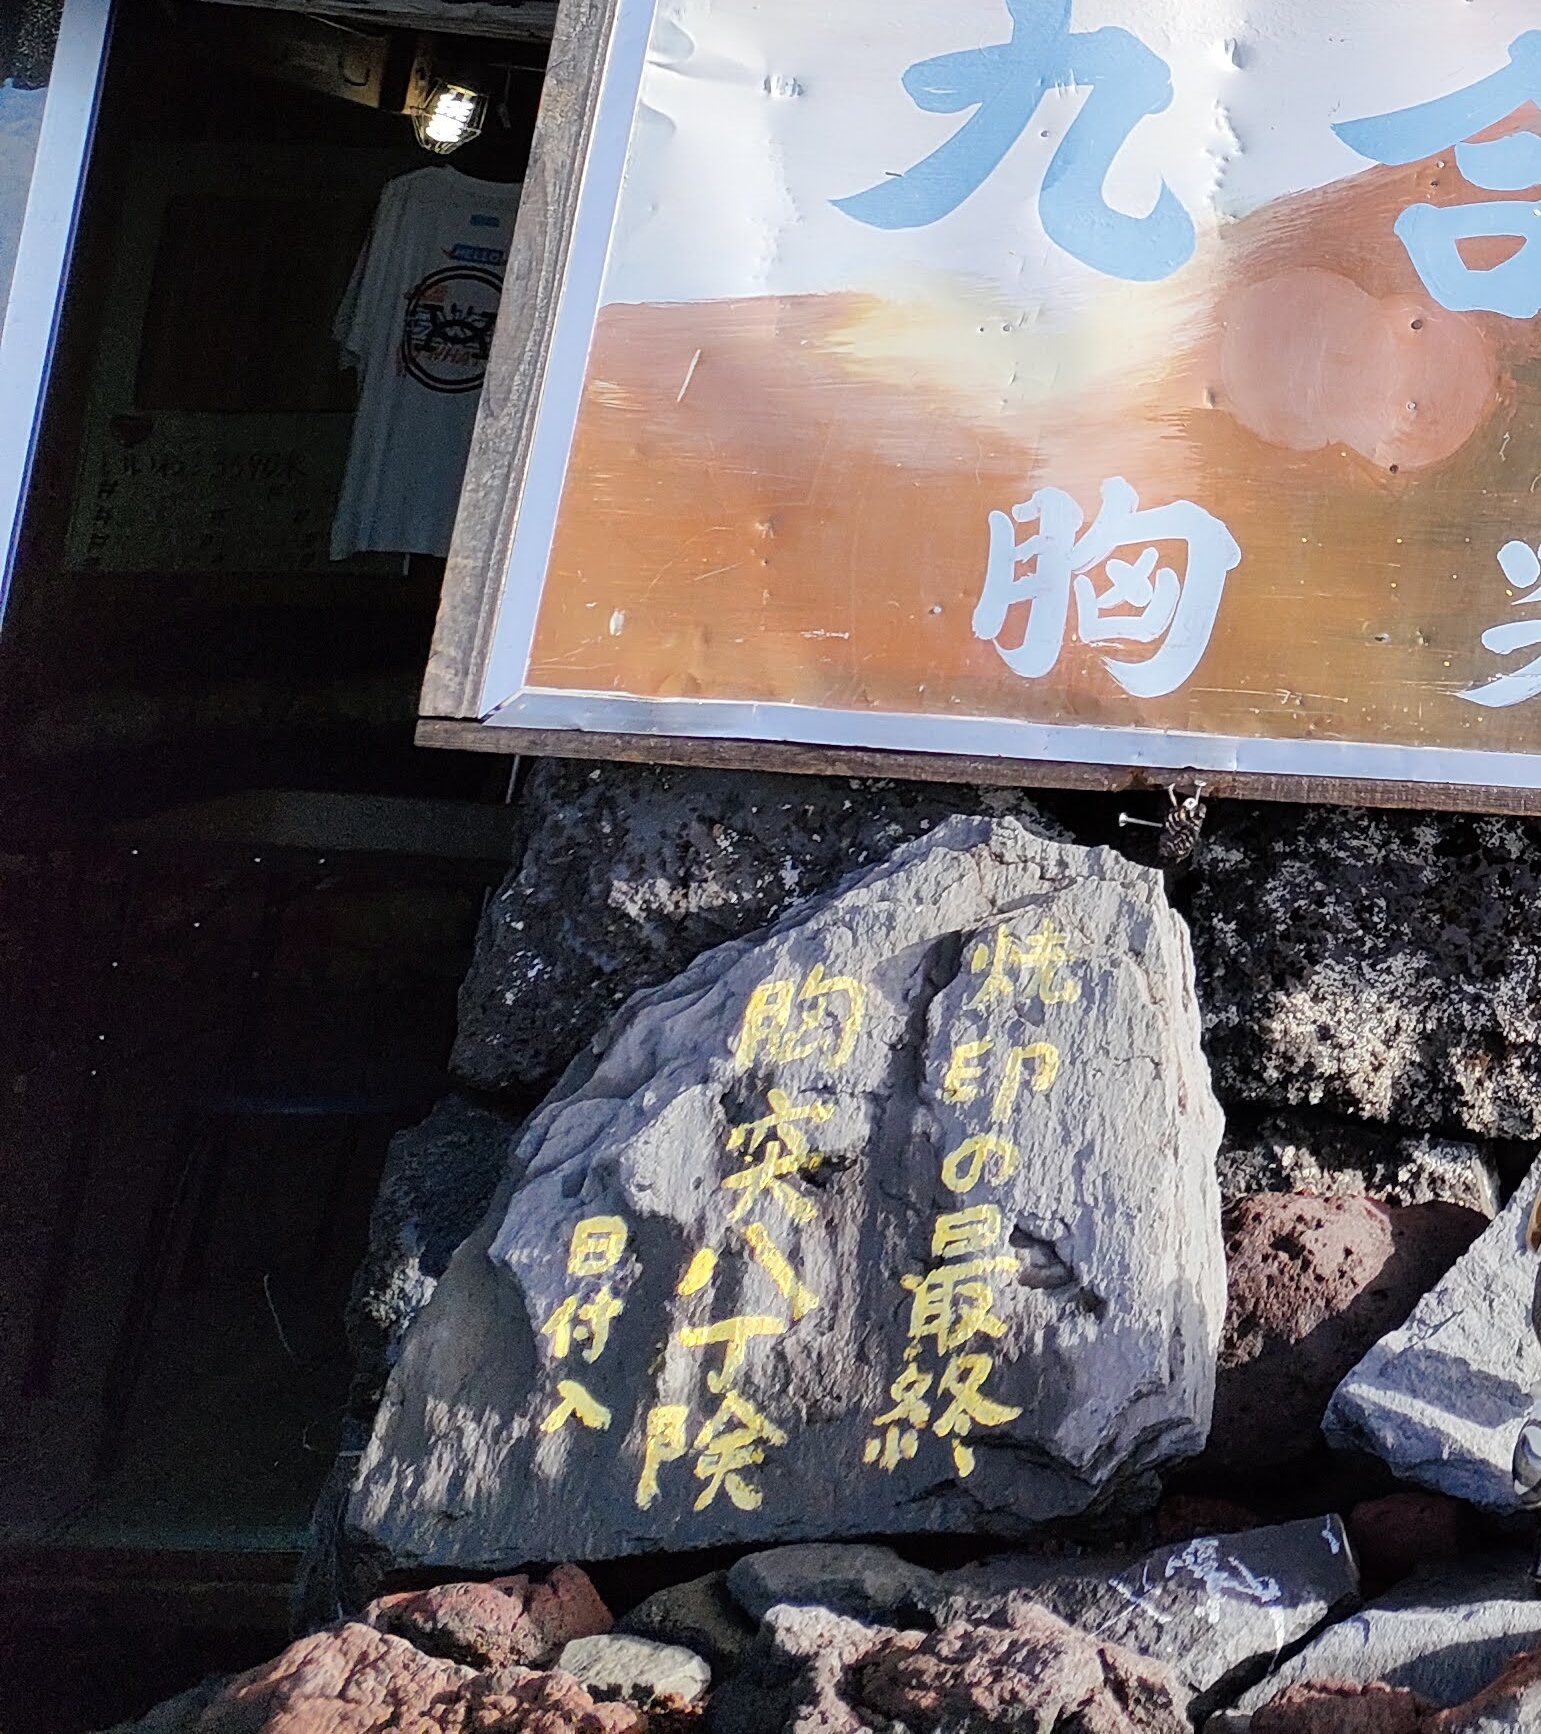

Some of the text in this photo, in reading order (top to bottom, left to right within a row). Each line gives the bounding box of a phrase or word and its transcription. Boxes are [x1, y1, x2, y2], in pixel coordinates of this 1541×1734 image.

[540, 1215, 628, 1433] 日付入
[864, 918, 1082, 1479] 焼印の最終
